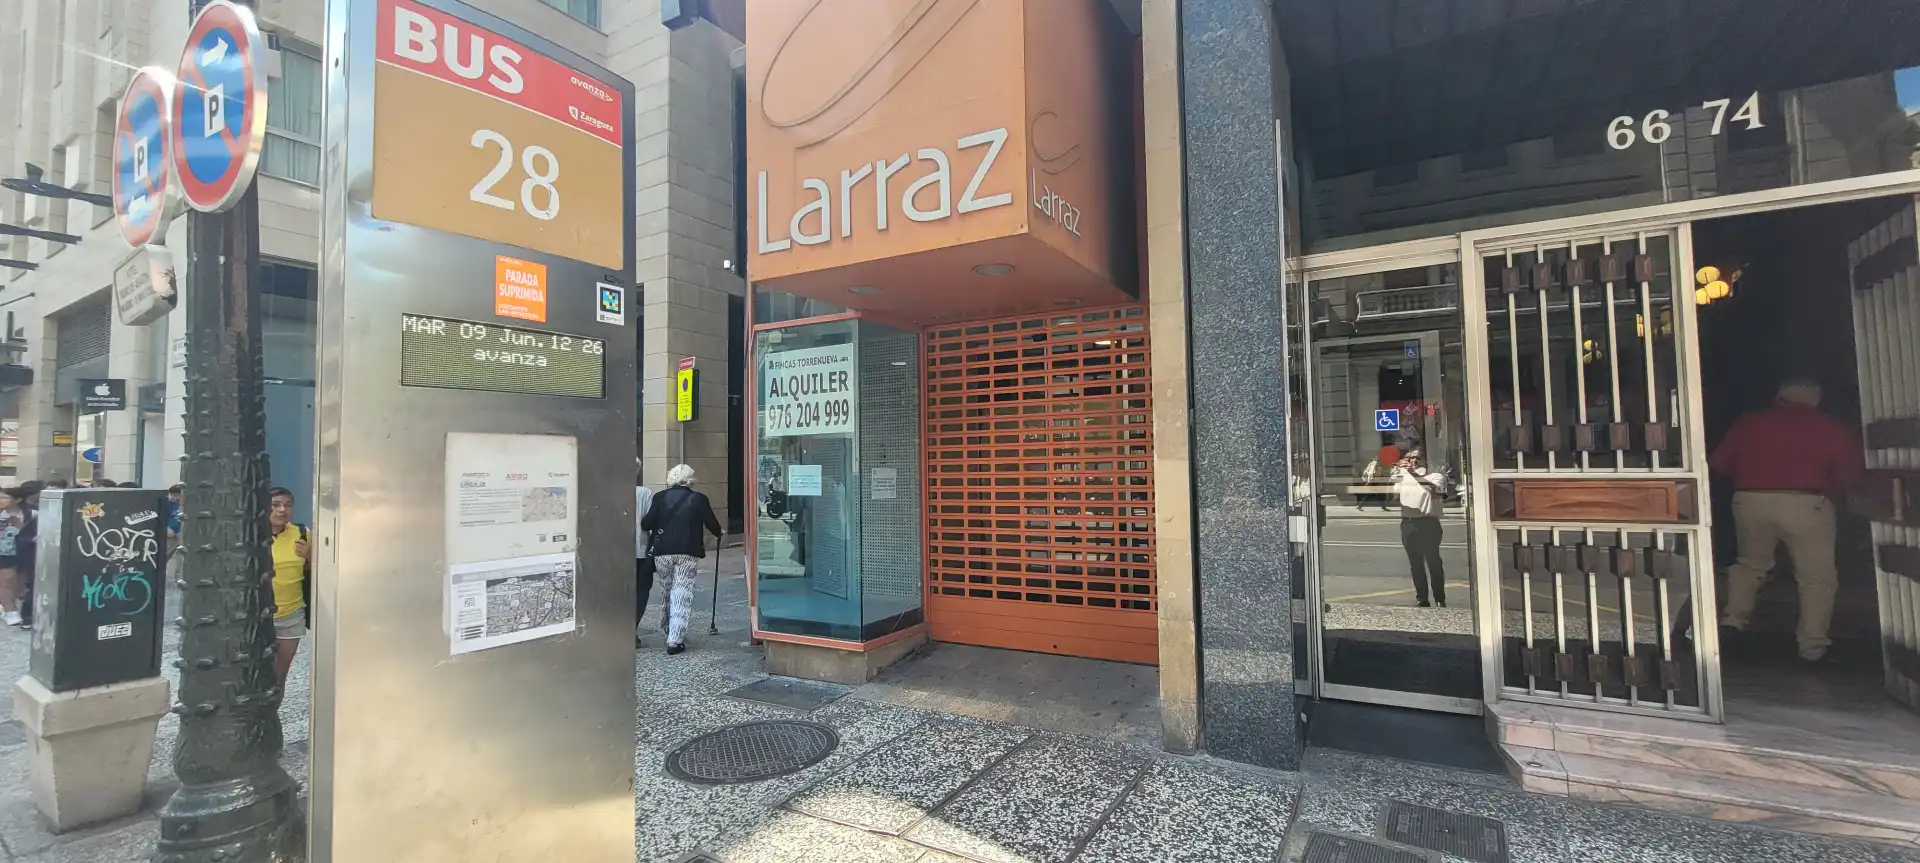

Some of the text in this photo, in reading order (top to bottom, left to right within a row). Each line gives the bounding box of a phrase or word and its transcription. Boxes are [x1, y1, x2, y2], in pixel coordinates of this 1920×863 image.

[393, 6, 525, 95] BUS
[570, 76, 605, 98] avanza
[208, 94, 219, 131] P
[579, 110, 614, 133] Zaragoza
[1607, 90, 1767, 150] 66 74
[137, 145, 145, 177] P
[469, 128, 560, 221] 28
[758, 126, 1013, 255] Larraz
[1031, 166, 1082, 238] Larraz
[499, 282, 545, 303] SUPRIMIDA
[504, 268, 539, 288] PARADA
[402, 315, 446, 336] MAR
[459, 323, 487, 340] 09
[582, 339, 604, 355] 26
[473, 348, 548, 367] avanza
[774, 359, 796, 370] FINCAS
[798, 354, 839, 368] TORRENUEVA
[769, 370, 850, 402] ALQUILER
[768, 398, 850, 430] 976 204 999
